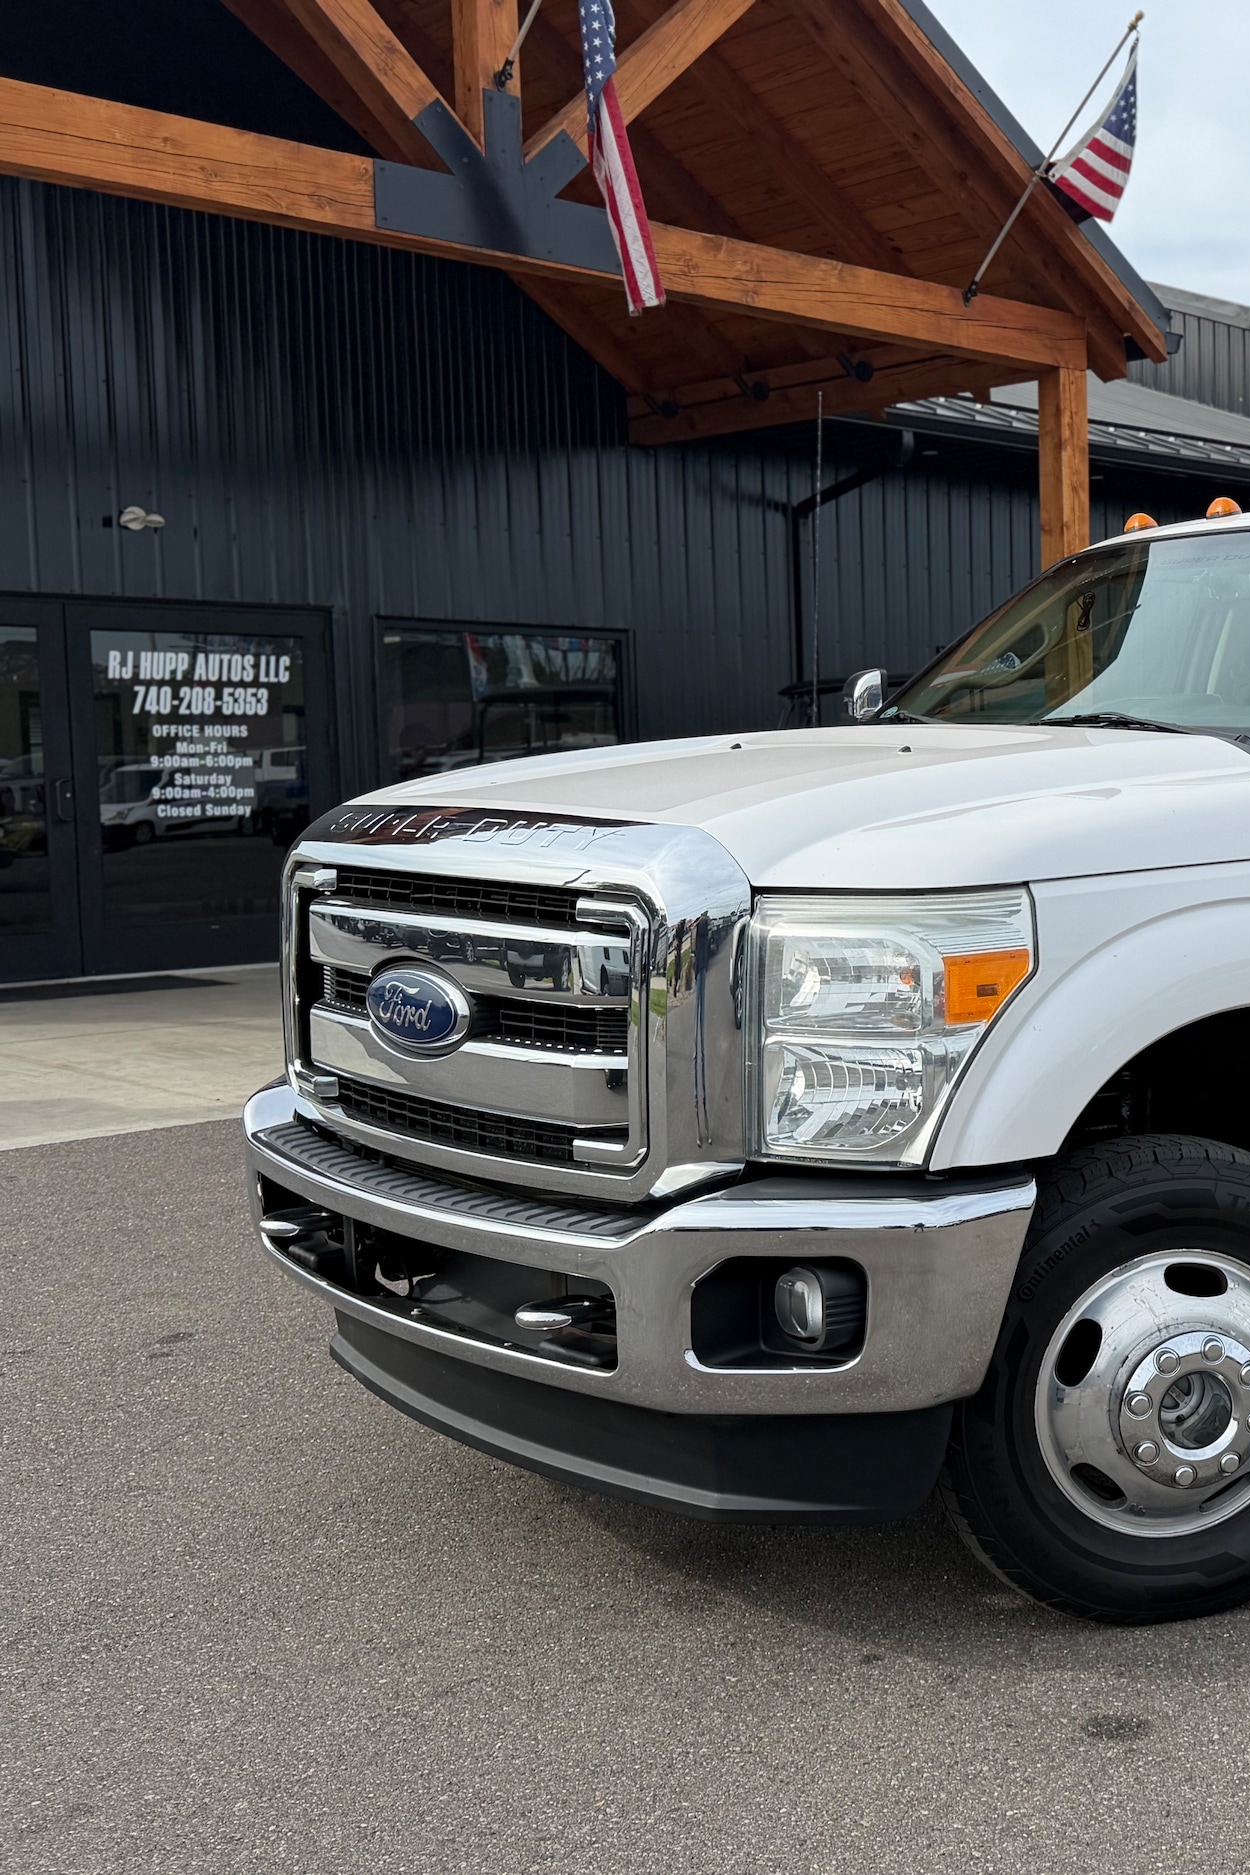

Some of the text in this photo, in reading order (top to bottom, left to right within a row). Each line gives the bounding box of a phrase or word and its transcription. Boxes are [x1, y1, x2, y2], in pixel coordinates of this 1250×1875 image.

[107, 650, 291, 683] RJ HUPP AUTOS LLC
[132, 685, 269, 716] 740-208-5353
[152, 724, 249, 738] OFFICE HOURS
[175, 741, 228, 754] Mon-Fri
[150, 755, 253, 769] 9:00am-6:00pm
[173, 772, 233, 787] Saturday
[151, 786, 255, 800] 9:00am-4:00pm
[156, 803, 252, 818] Closed Sunday
[329, 811, 626, 851] SUPER DUTY
[379, 981, 433, 1031] Ford
[1017, 1225, 1093, 1303] Continental
